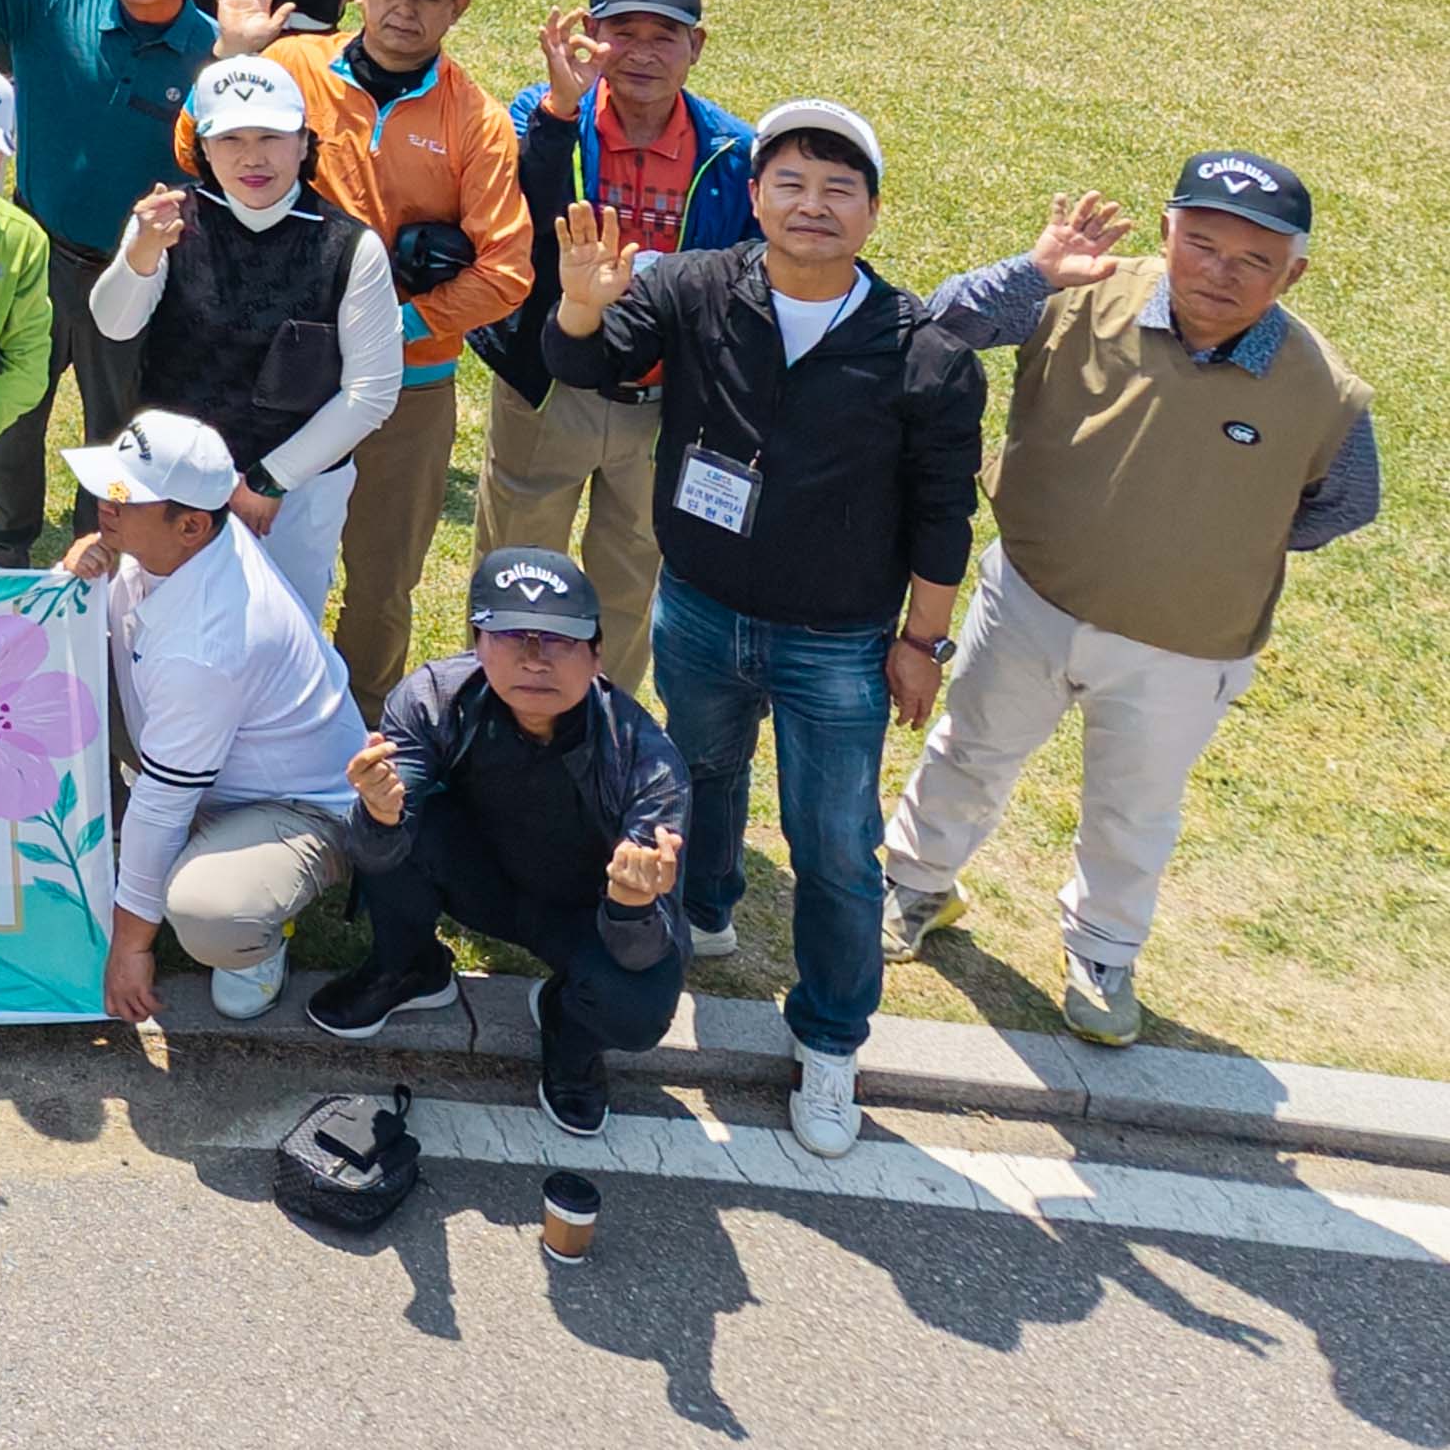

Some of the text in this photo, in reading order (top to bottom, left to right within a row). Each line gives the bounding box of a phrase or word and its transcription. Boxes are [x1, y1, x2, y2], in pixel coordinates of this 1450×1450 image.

[214, 72, 275, 94] Callaway
[1198, 159, 1279, 191] Callaway
[497, 564, 568, 594] Callaway
